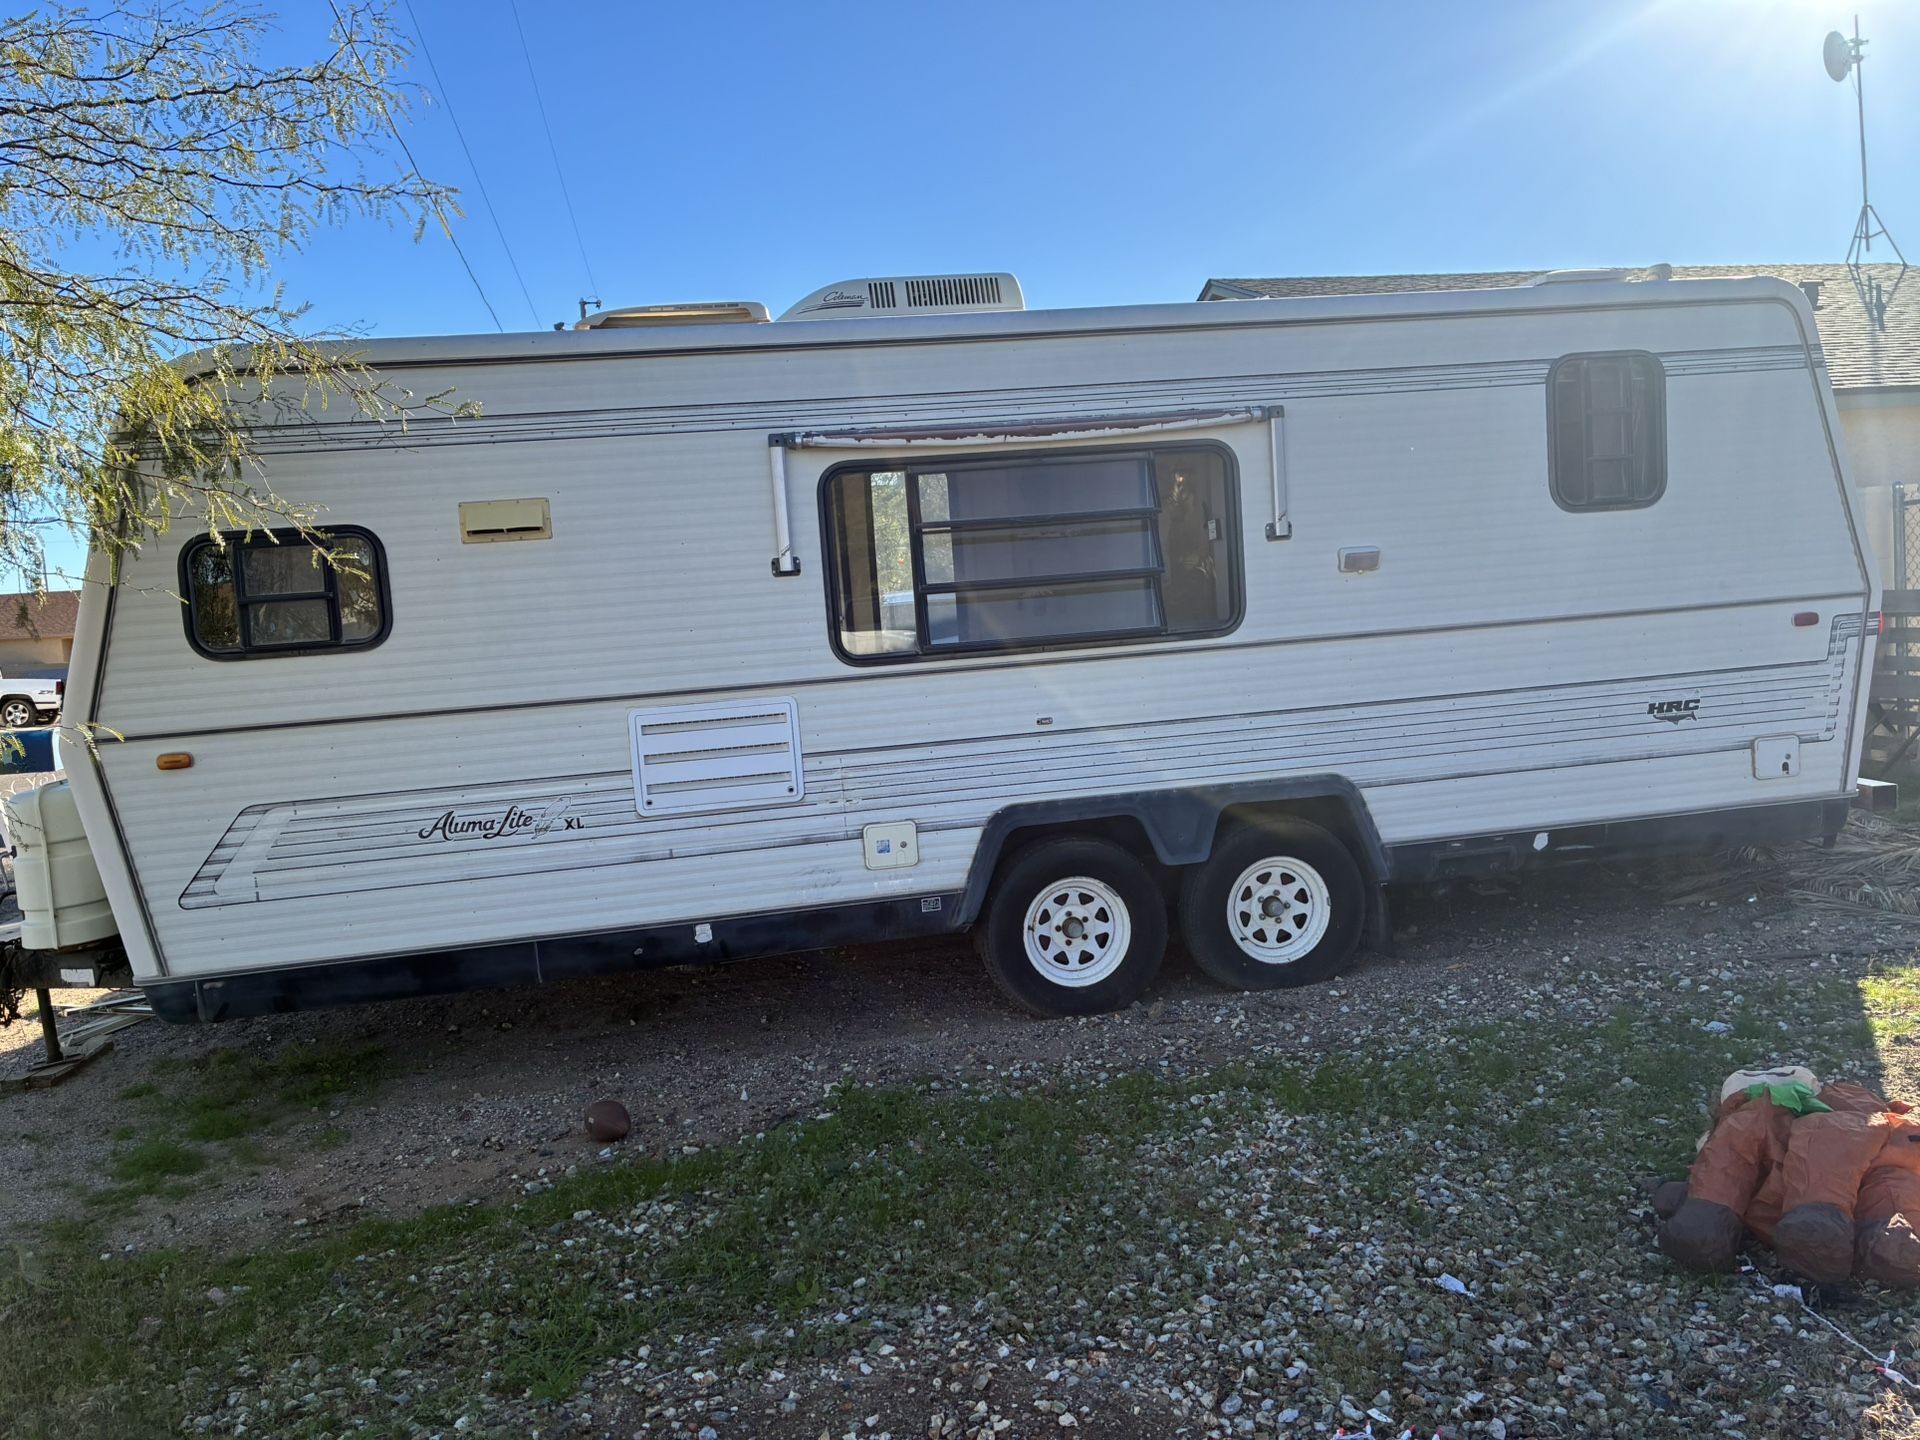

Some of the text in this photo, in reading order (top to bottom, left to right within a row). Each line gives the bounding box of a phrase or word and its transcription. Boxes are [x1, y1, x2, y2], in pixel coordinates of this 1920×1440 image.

[823, 291, 867, 302] Coleman
[1647, 699, 1701, 714] HRC
[564, 817, 585, 831] XL
